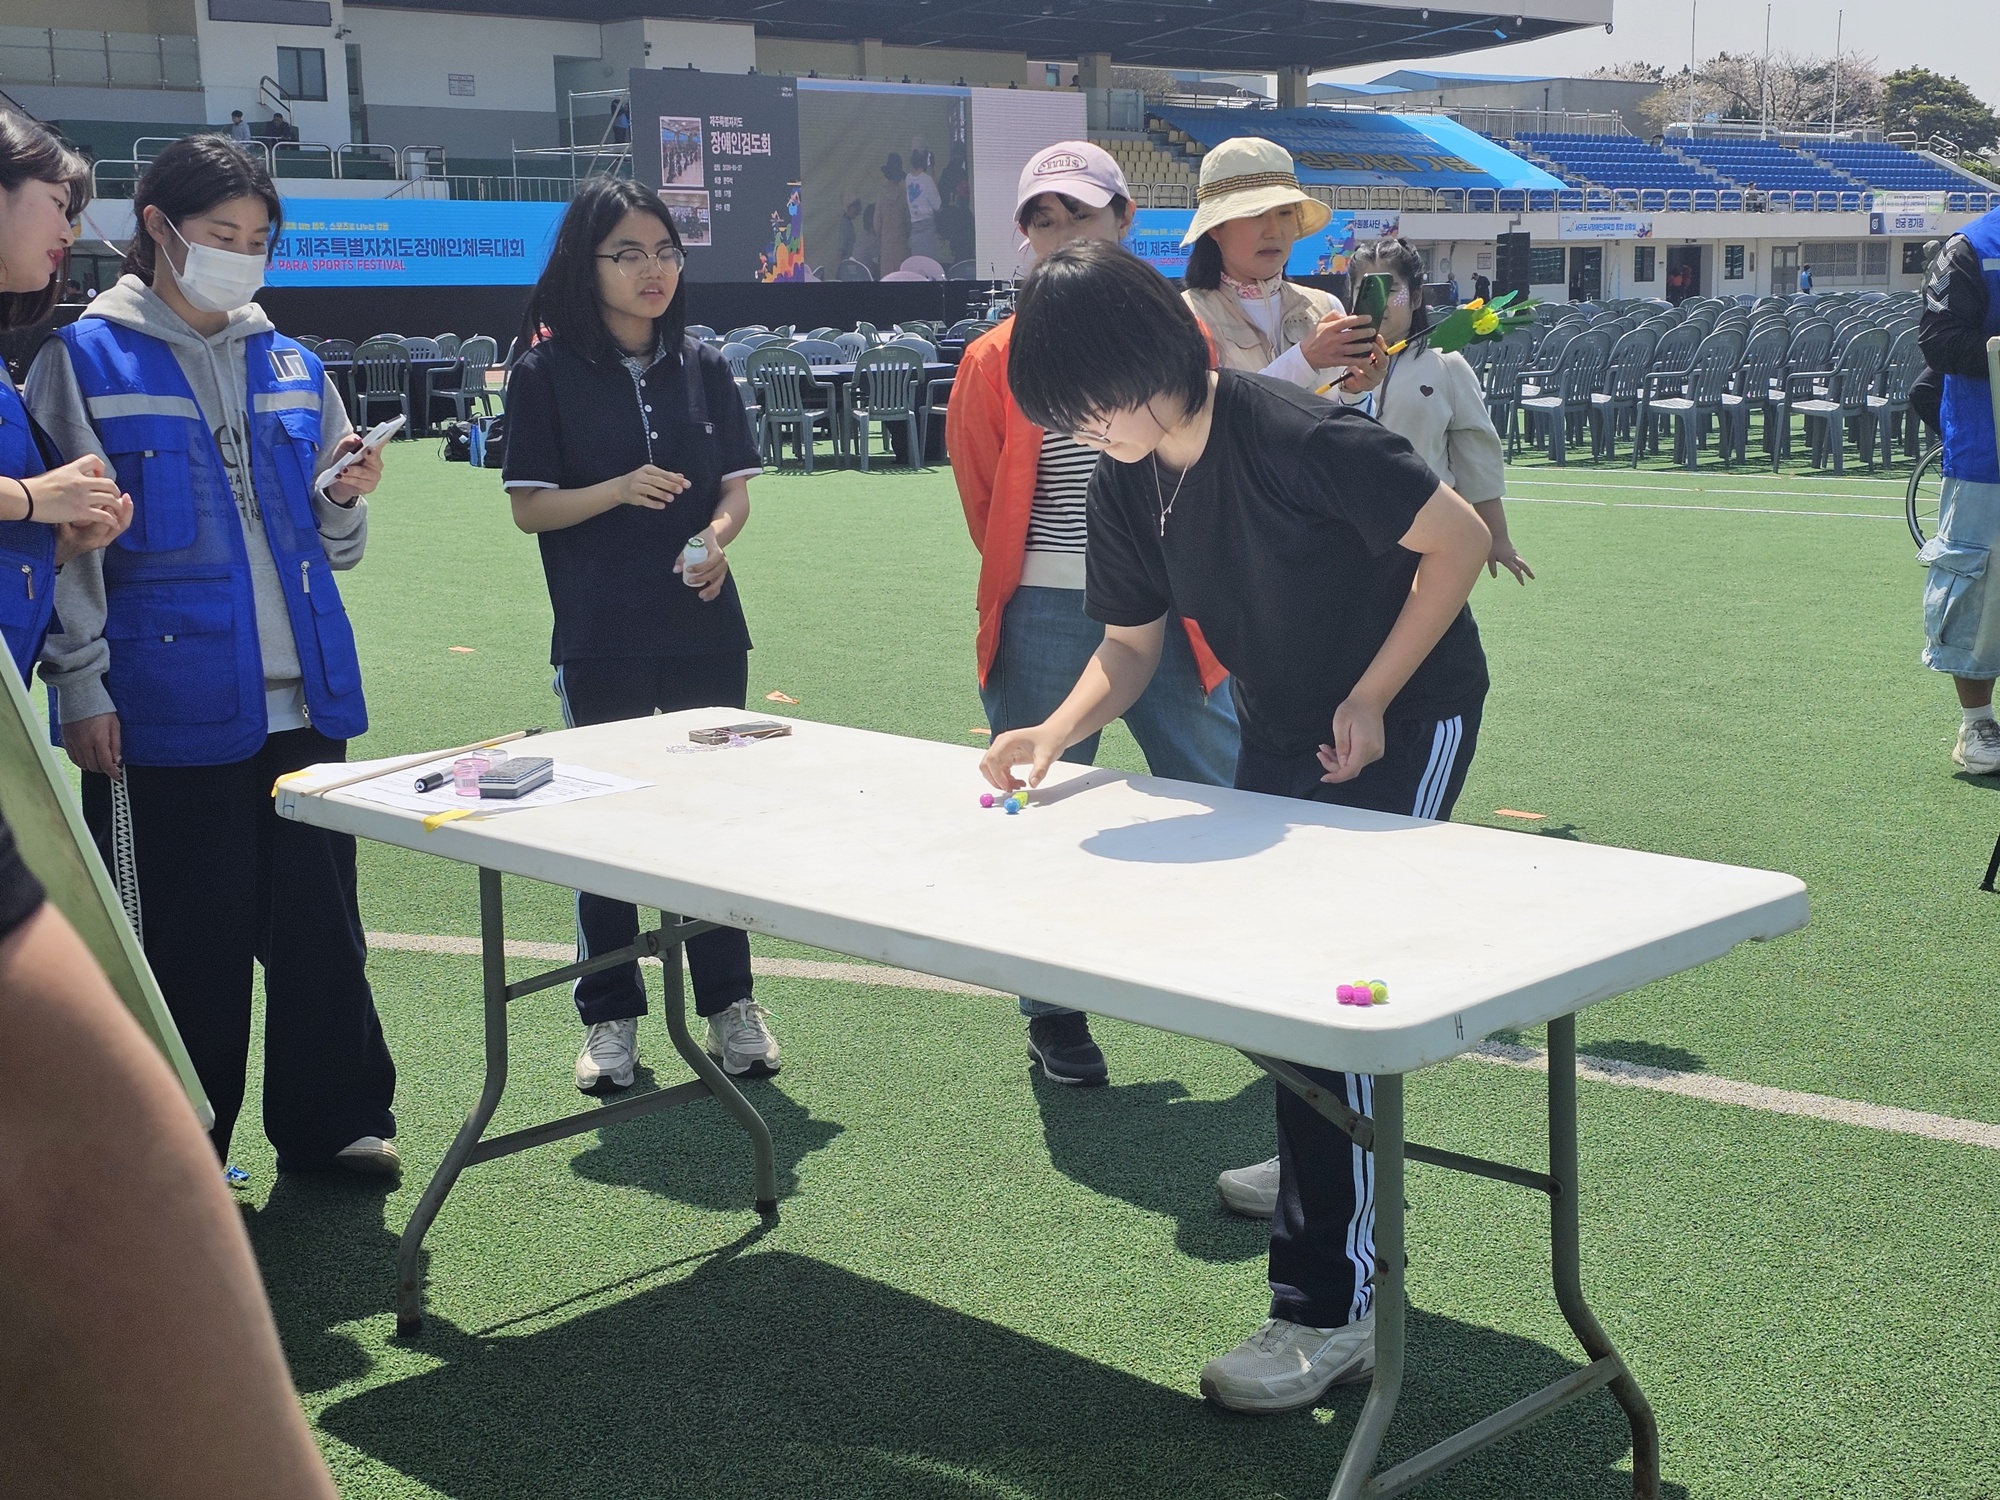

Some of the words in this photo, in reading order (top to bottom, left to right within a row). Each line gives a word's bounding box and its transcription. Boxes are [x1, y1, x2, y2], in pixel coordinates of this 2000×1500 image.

[709, 115, 743, 127] 제주특별자치도
[710, 131, 771, 156] 장애인검도회
[1291, 150, 1424, 172] 성공개최
[1412, 155, 1488, 173] 기원
[1908, 217, 1924, 228] 경기장
[296, 237, 525, 258] 제주특별자치도장애인체육대회
[278, 259, 309, 271] PARA
[312, 259, 354, 271] SPORTS
[357, 259, 406, 271] FESTIVAL
